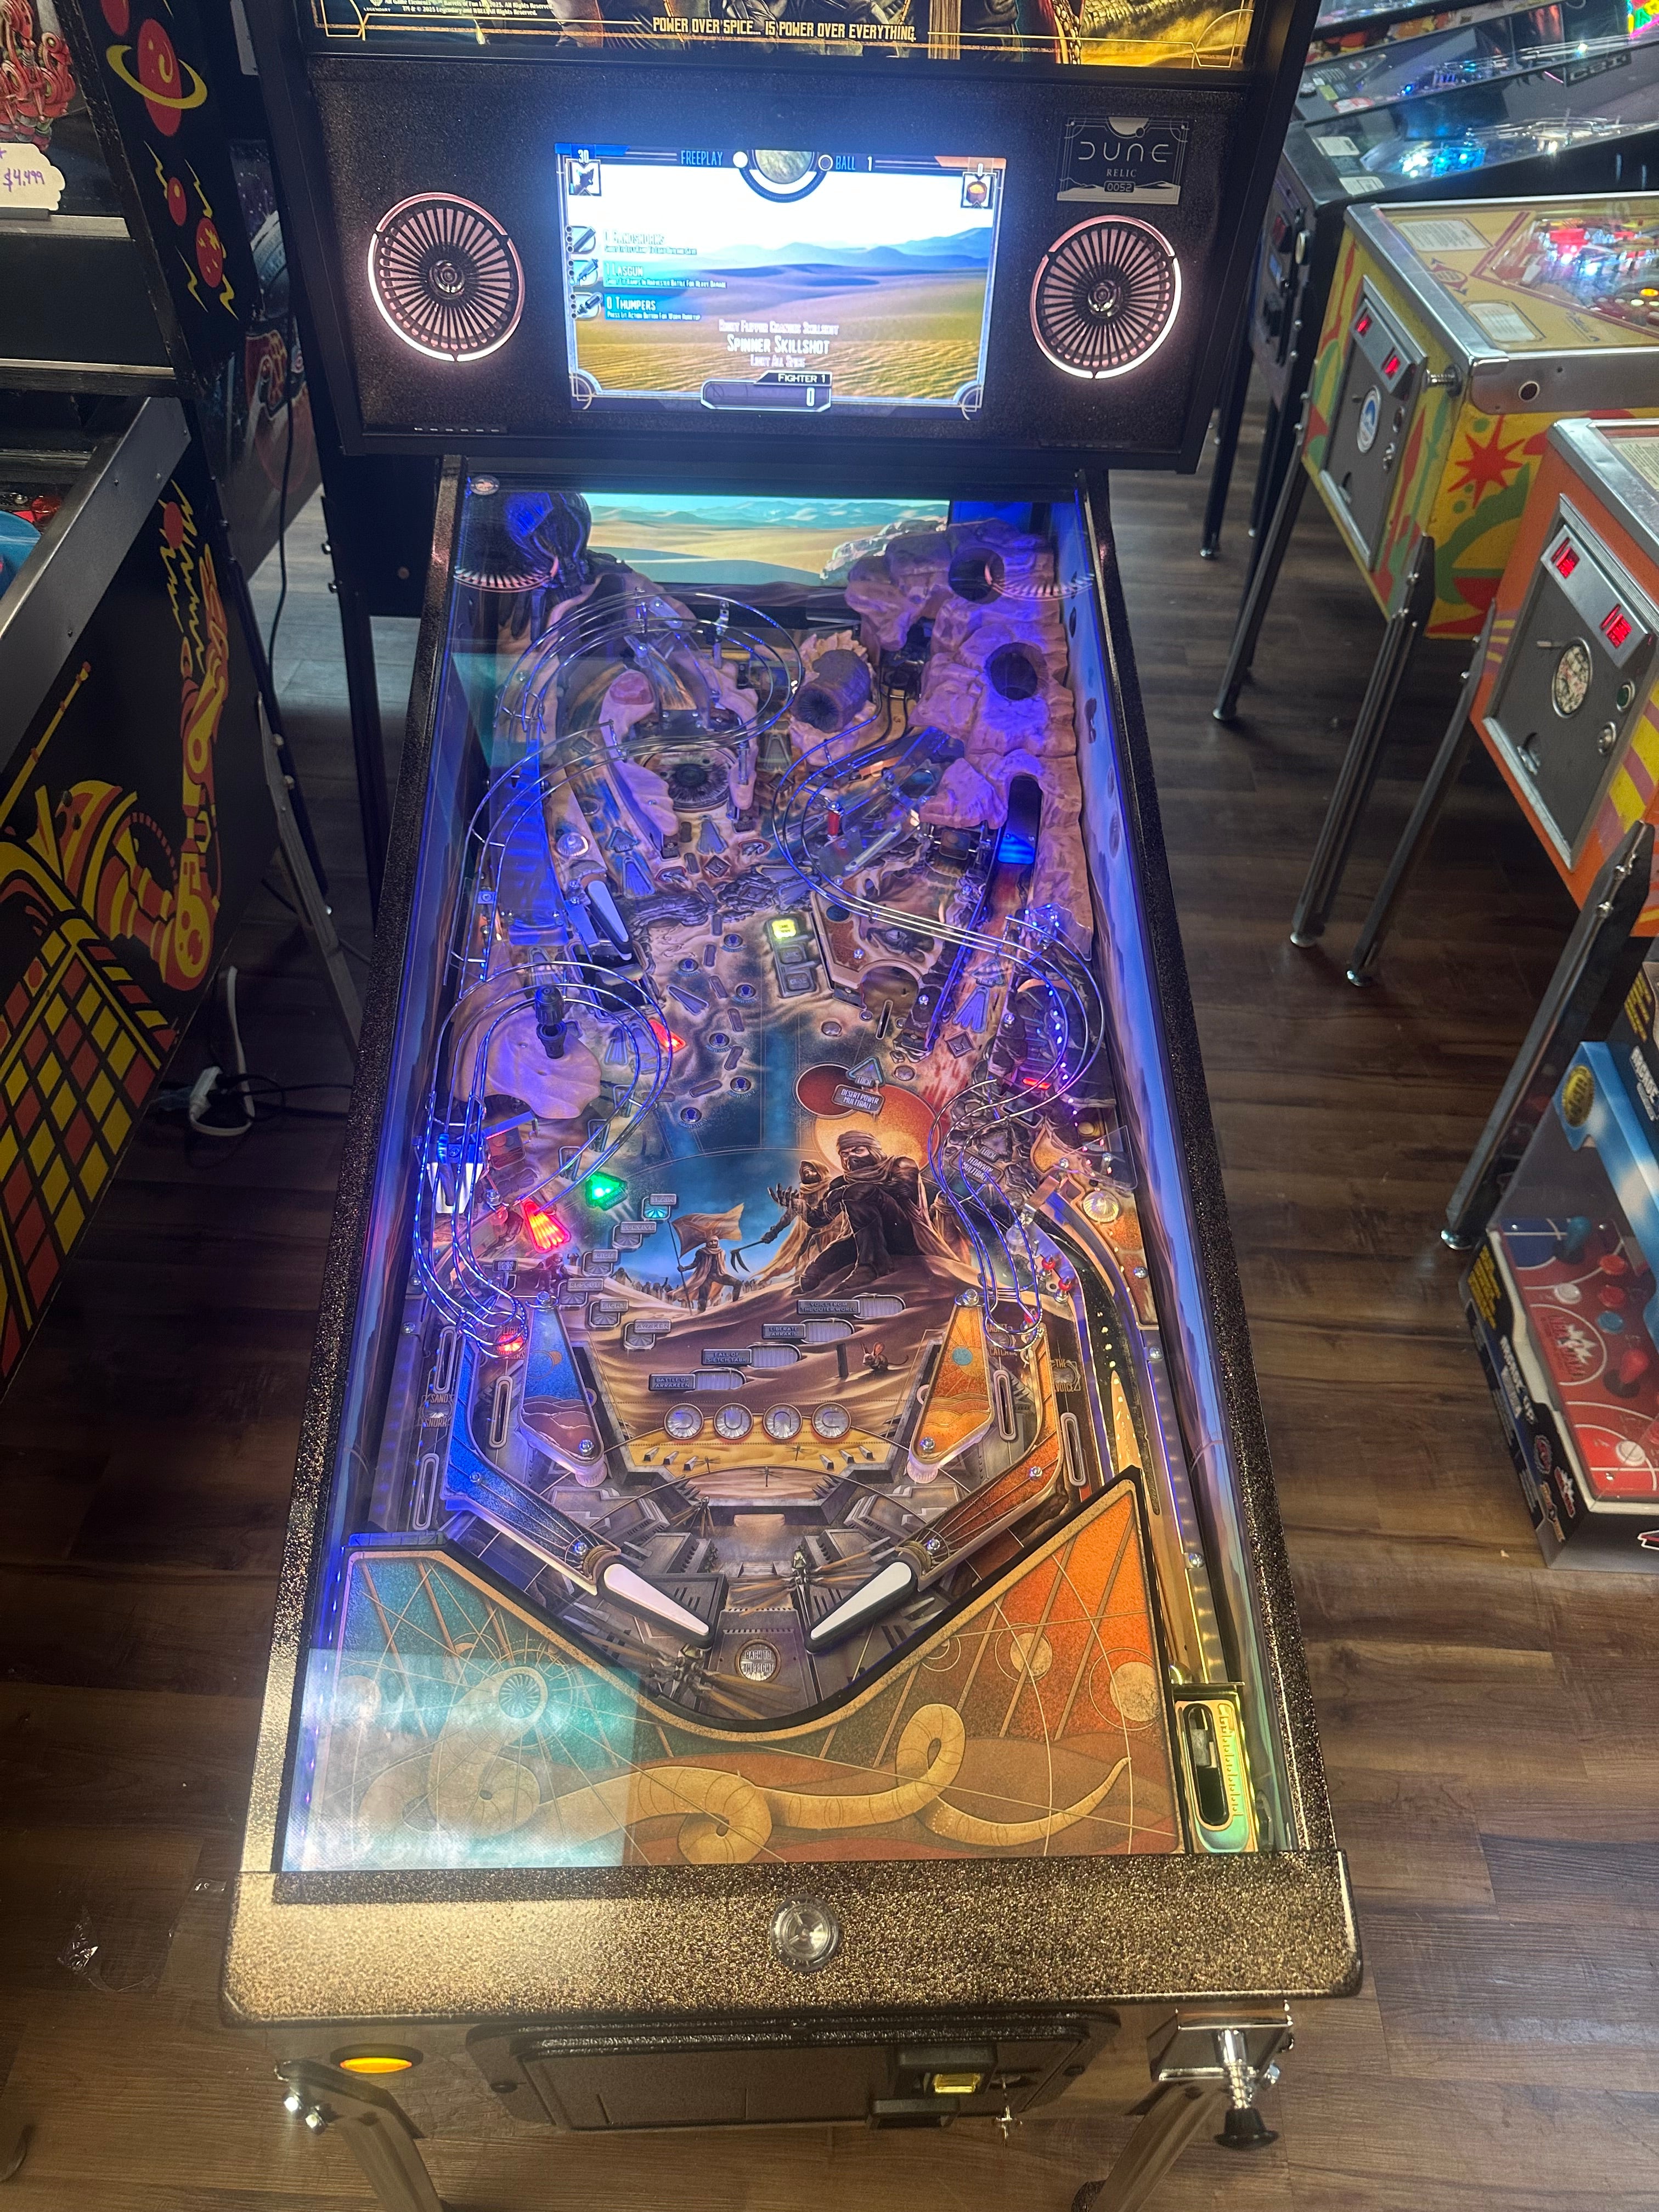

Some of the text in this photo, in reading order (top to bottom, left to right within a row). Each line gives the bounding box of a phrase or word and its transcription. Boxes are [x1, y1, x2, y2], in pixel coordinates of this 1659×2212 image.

[653, 17, 917, 42] POWER OVER SPICE... IS POWER OVER EVERYTHING.
[578, 149, 589, 163] 30
[1078, 141, 1170, 162] DUNE
[680, 150, 723, 166] FREEPLAY
[836, 156, 872, 171] BALL 1
[1107, 168, 1137, 177] RELIC
[1107, 183, 1132, 192] 0052
[616, 296, 656, 311] THUMPERS
[778, 373, 826, 383] FIGHTER 1
[806, 387, 815, 407] 0
[841, 1089, 879, 1104] DESERT POWER
[843, 1097, 871, 1109] MULTIBALL
[1056, 1359, 1066, 1368] THE
[1055, 1383, 1074, 1392] VOICE
[431, 1394, 448, 1403] SAND
[746, 1650, 771, 1659] BACK TO
[743, 1663, 773, 1672] THE FIGHT
